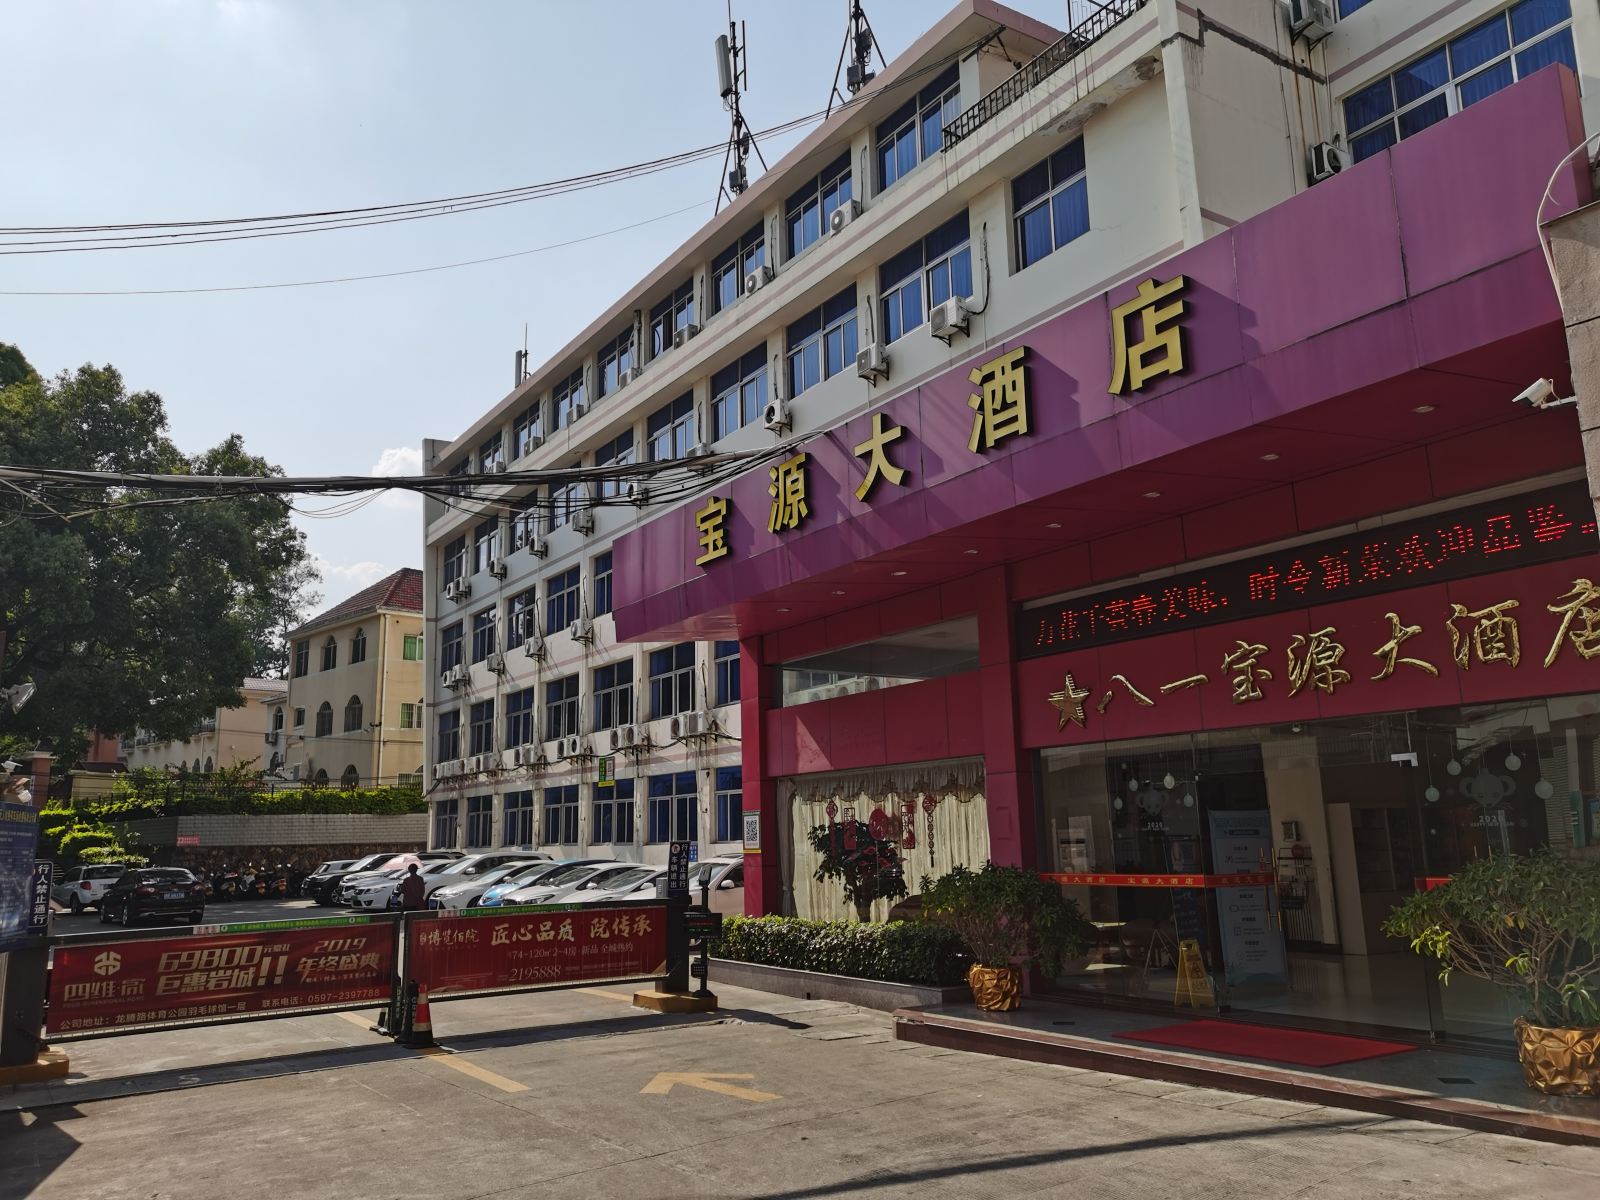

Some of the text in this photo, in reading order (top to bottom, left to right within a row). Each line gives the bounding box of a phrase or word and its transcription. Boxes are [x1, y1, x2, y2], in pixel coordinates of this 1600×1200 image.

[694, 274, 1190, 567] 宝源大酒店
[1096, 578, 1600, 714] 八一宝源大酒店
[33, 864, 50, 925] 行人禁止通行
[314, 937, 367, 953] 2019
[491, 914, 653, 946] 匠心品质 院传承
[296, 951, 381, 983] 年终盛典
[509, 966, 561, 982] 2195888
